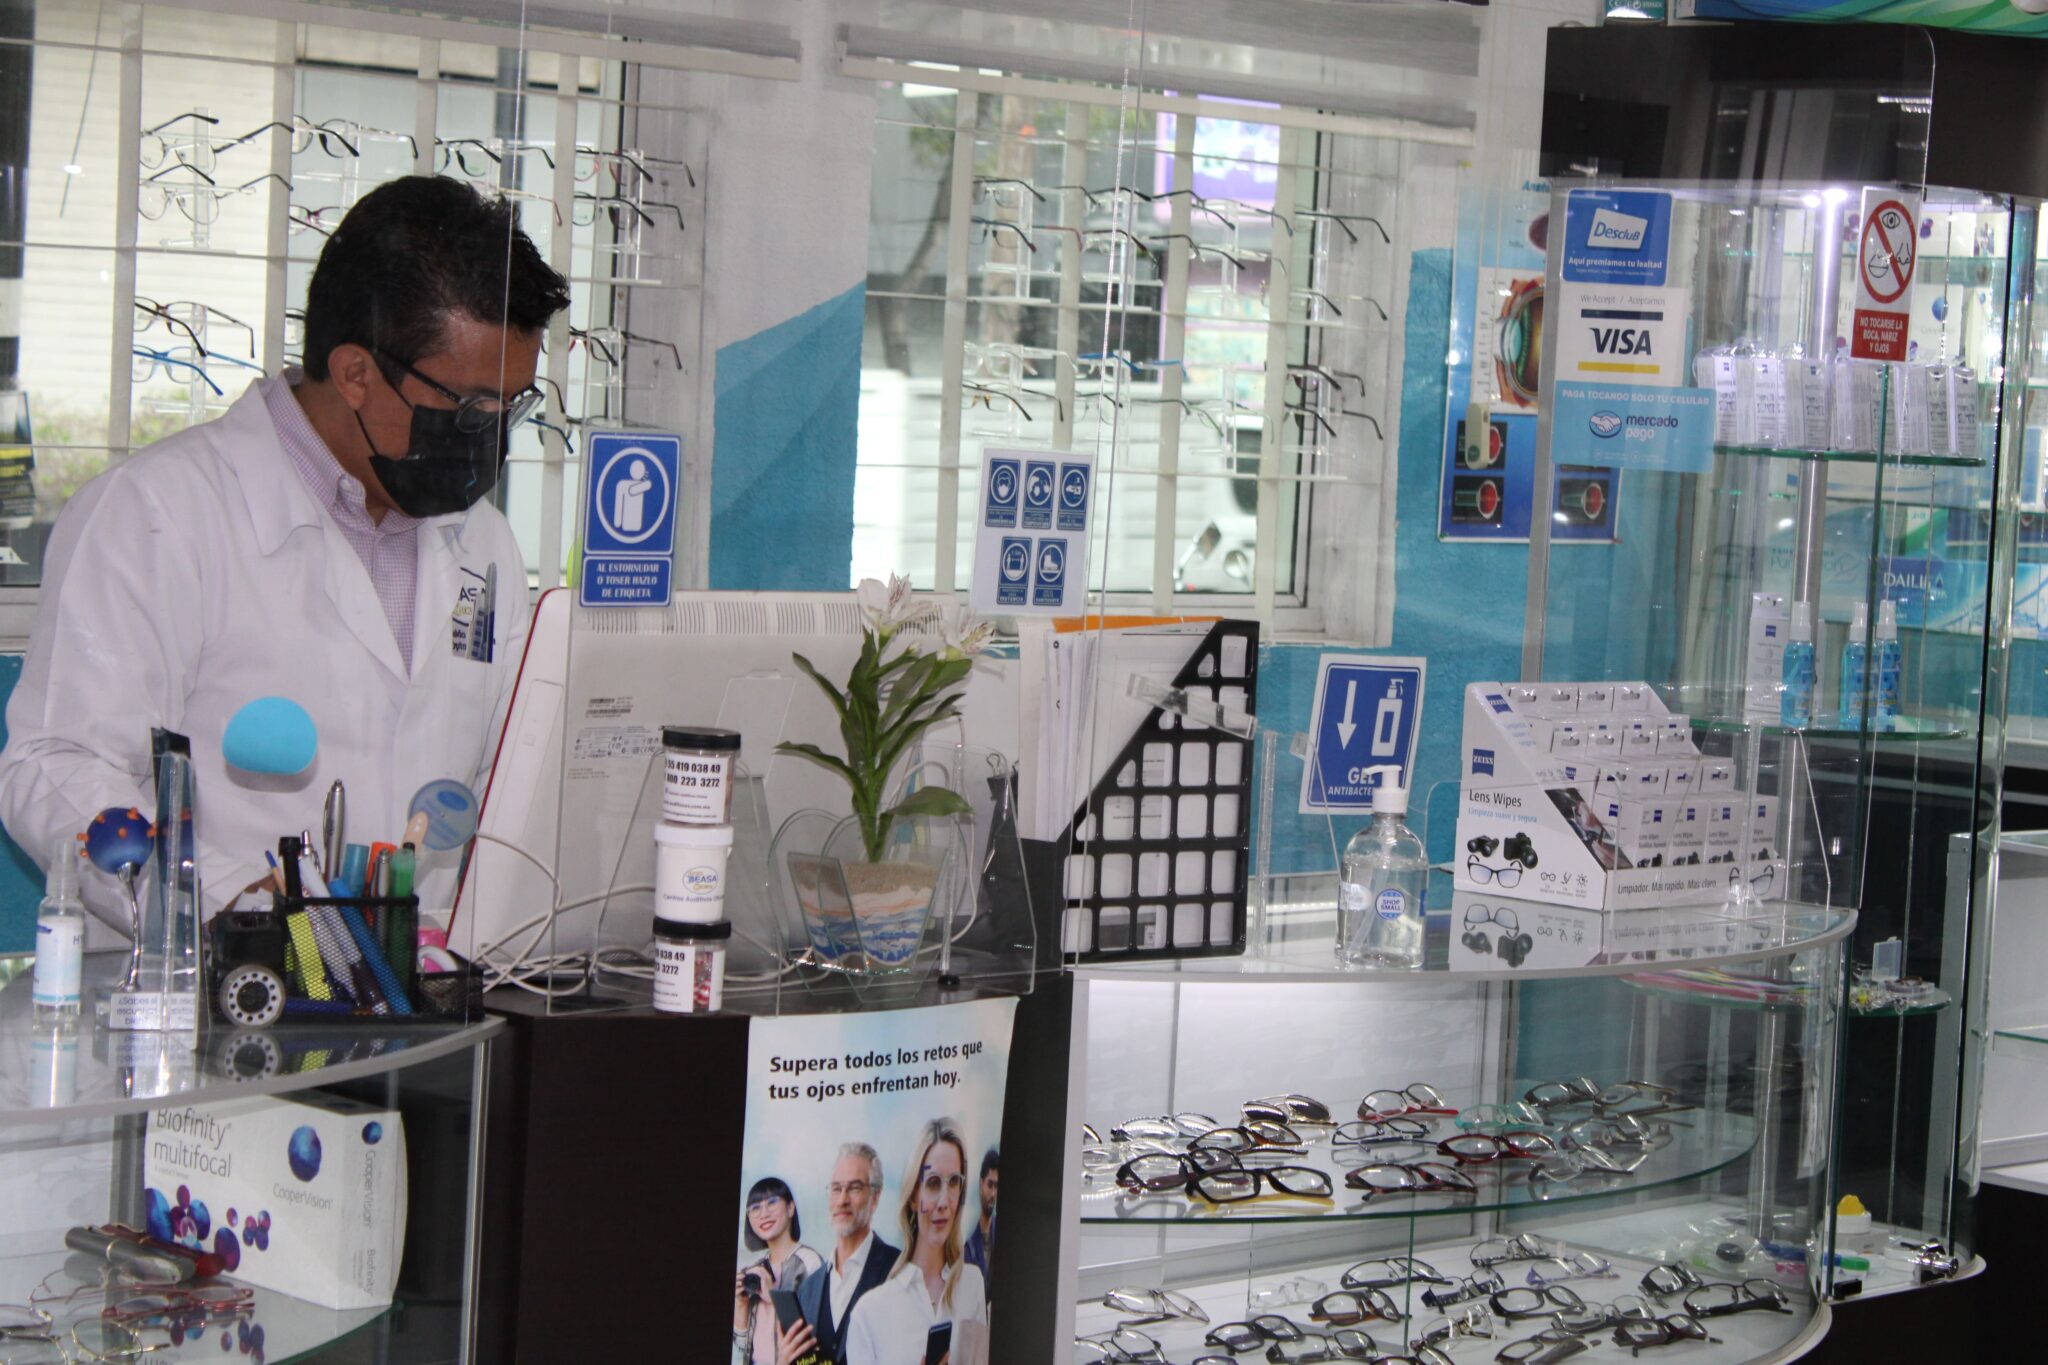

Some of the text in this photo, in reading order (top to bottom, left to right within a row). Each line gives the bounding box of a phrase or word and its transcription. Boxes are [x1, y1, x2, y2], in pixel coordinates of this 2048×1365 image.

[1586, 257, 1626, 268] premiamos
[1628, 259, 1634, 268] tu
[1637, 259, 1662, 269] lealtad
[1580, 294, 1592, 303] We
[1593, 295, 1616, 305] Accept
[1860, 316, 1903, 330] NO TOCARSE LA
[1589, 327, 1652, 356] VISA
[1881, 330, 1898, 342] NARIZ
[1869, 342, 1889, 354] Y OJOS
[1562, 389, 1710, 405] PAGA TOCANDO SOLO TU CELULAR
[1626, 415, 1678, 428] mercado
[1625, 427, 1655, 442] pago
[597, 563, 659, 573] AL ESTORNUDAR
[597, 576, 657, 585] O TOSER HAZLO
[602, 588, 651, 598] DE ETIQUETA
[1473, 755, 1494, 765] ZEISS
[676, 761, 690, 774] 419
[691, 762, 709, 774] 038
[710, 764, 721, 774] 49
[681, 775, 697, 787] 223
[700, 778, 721, 788] 3272
[1469, 788, 1522, 809] Lens Wipes
[1468, 807, 1494, 818] Limpieza
[1518, 814, 1538, 823] segura
[1618, 881, 1650, 895] Limpiador.
[674, 951, 686, 962] 49
[662, 963, 680, 976] 3272
[770, 1041, 983, 1077] Supera todos los retos que
[769, 1070, 961, 1102] tus ojos enfrentan hoy.
[153, 1141, 231, 1179] multifocal
[362, 1149, 376, 1230] CooperVision
[273, 1182, 331, 1211] CooperVision
[364, 1249, 376, 1296] Biofinity
